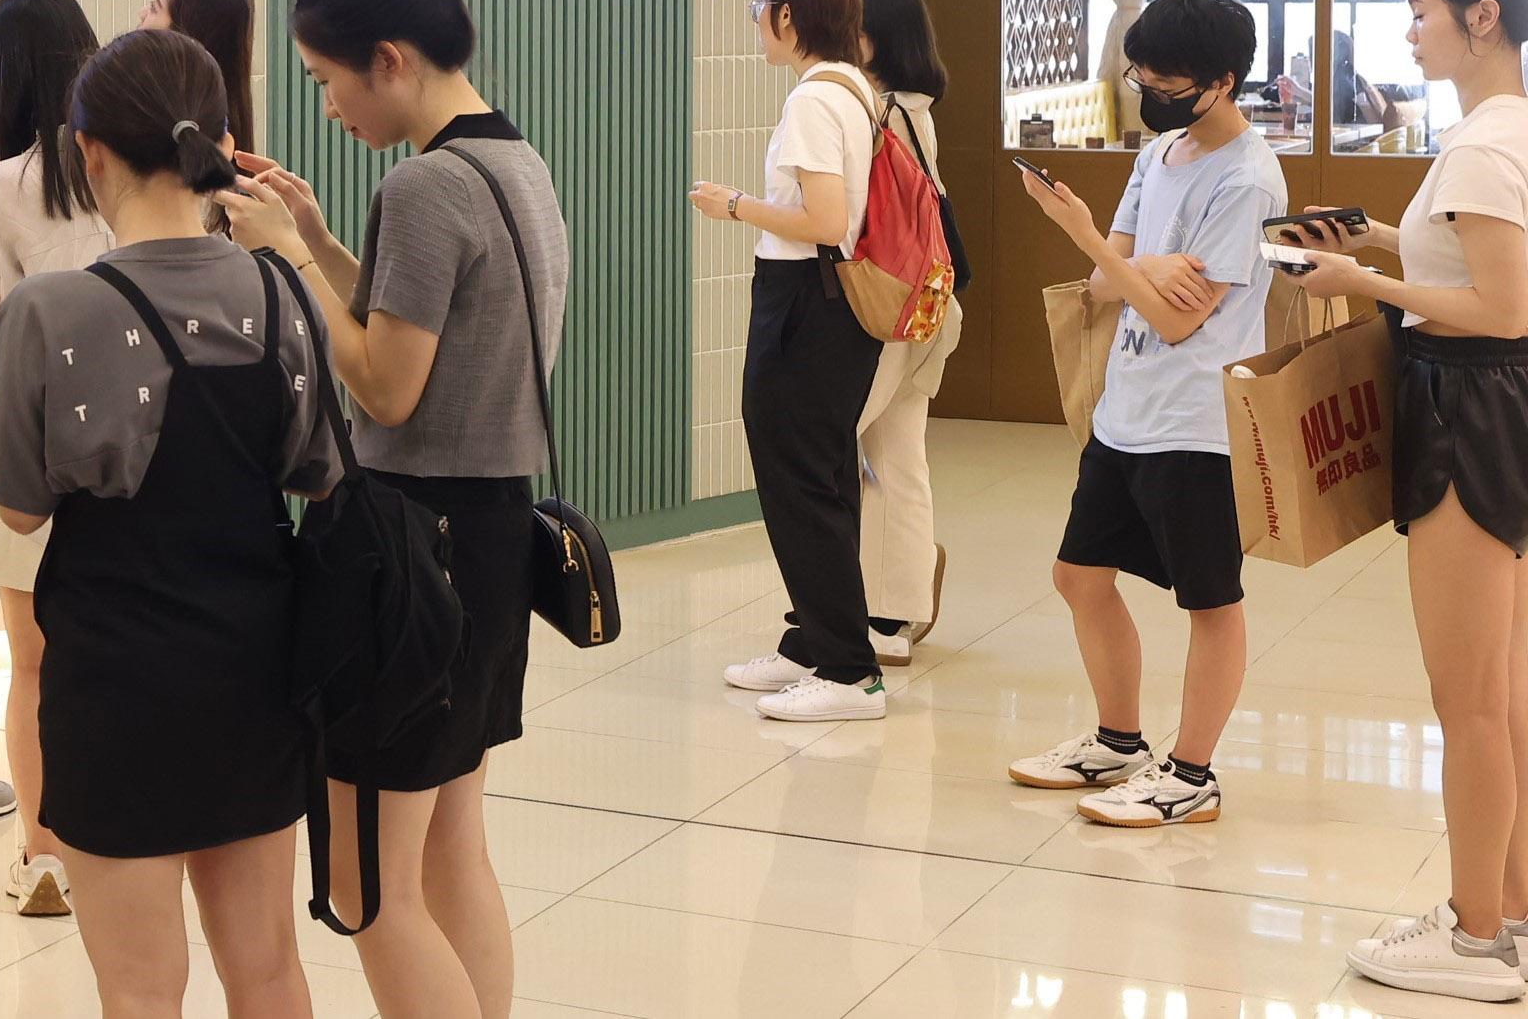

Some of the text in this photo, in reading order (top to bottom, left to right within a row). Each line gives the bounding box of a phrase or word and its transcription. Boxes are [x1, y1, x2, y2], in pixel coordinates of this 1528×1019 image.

[1299, 379, 1381, 470] MUJI
[1315, 443, 1383, 496] 無印良品
